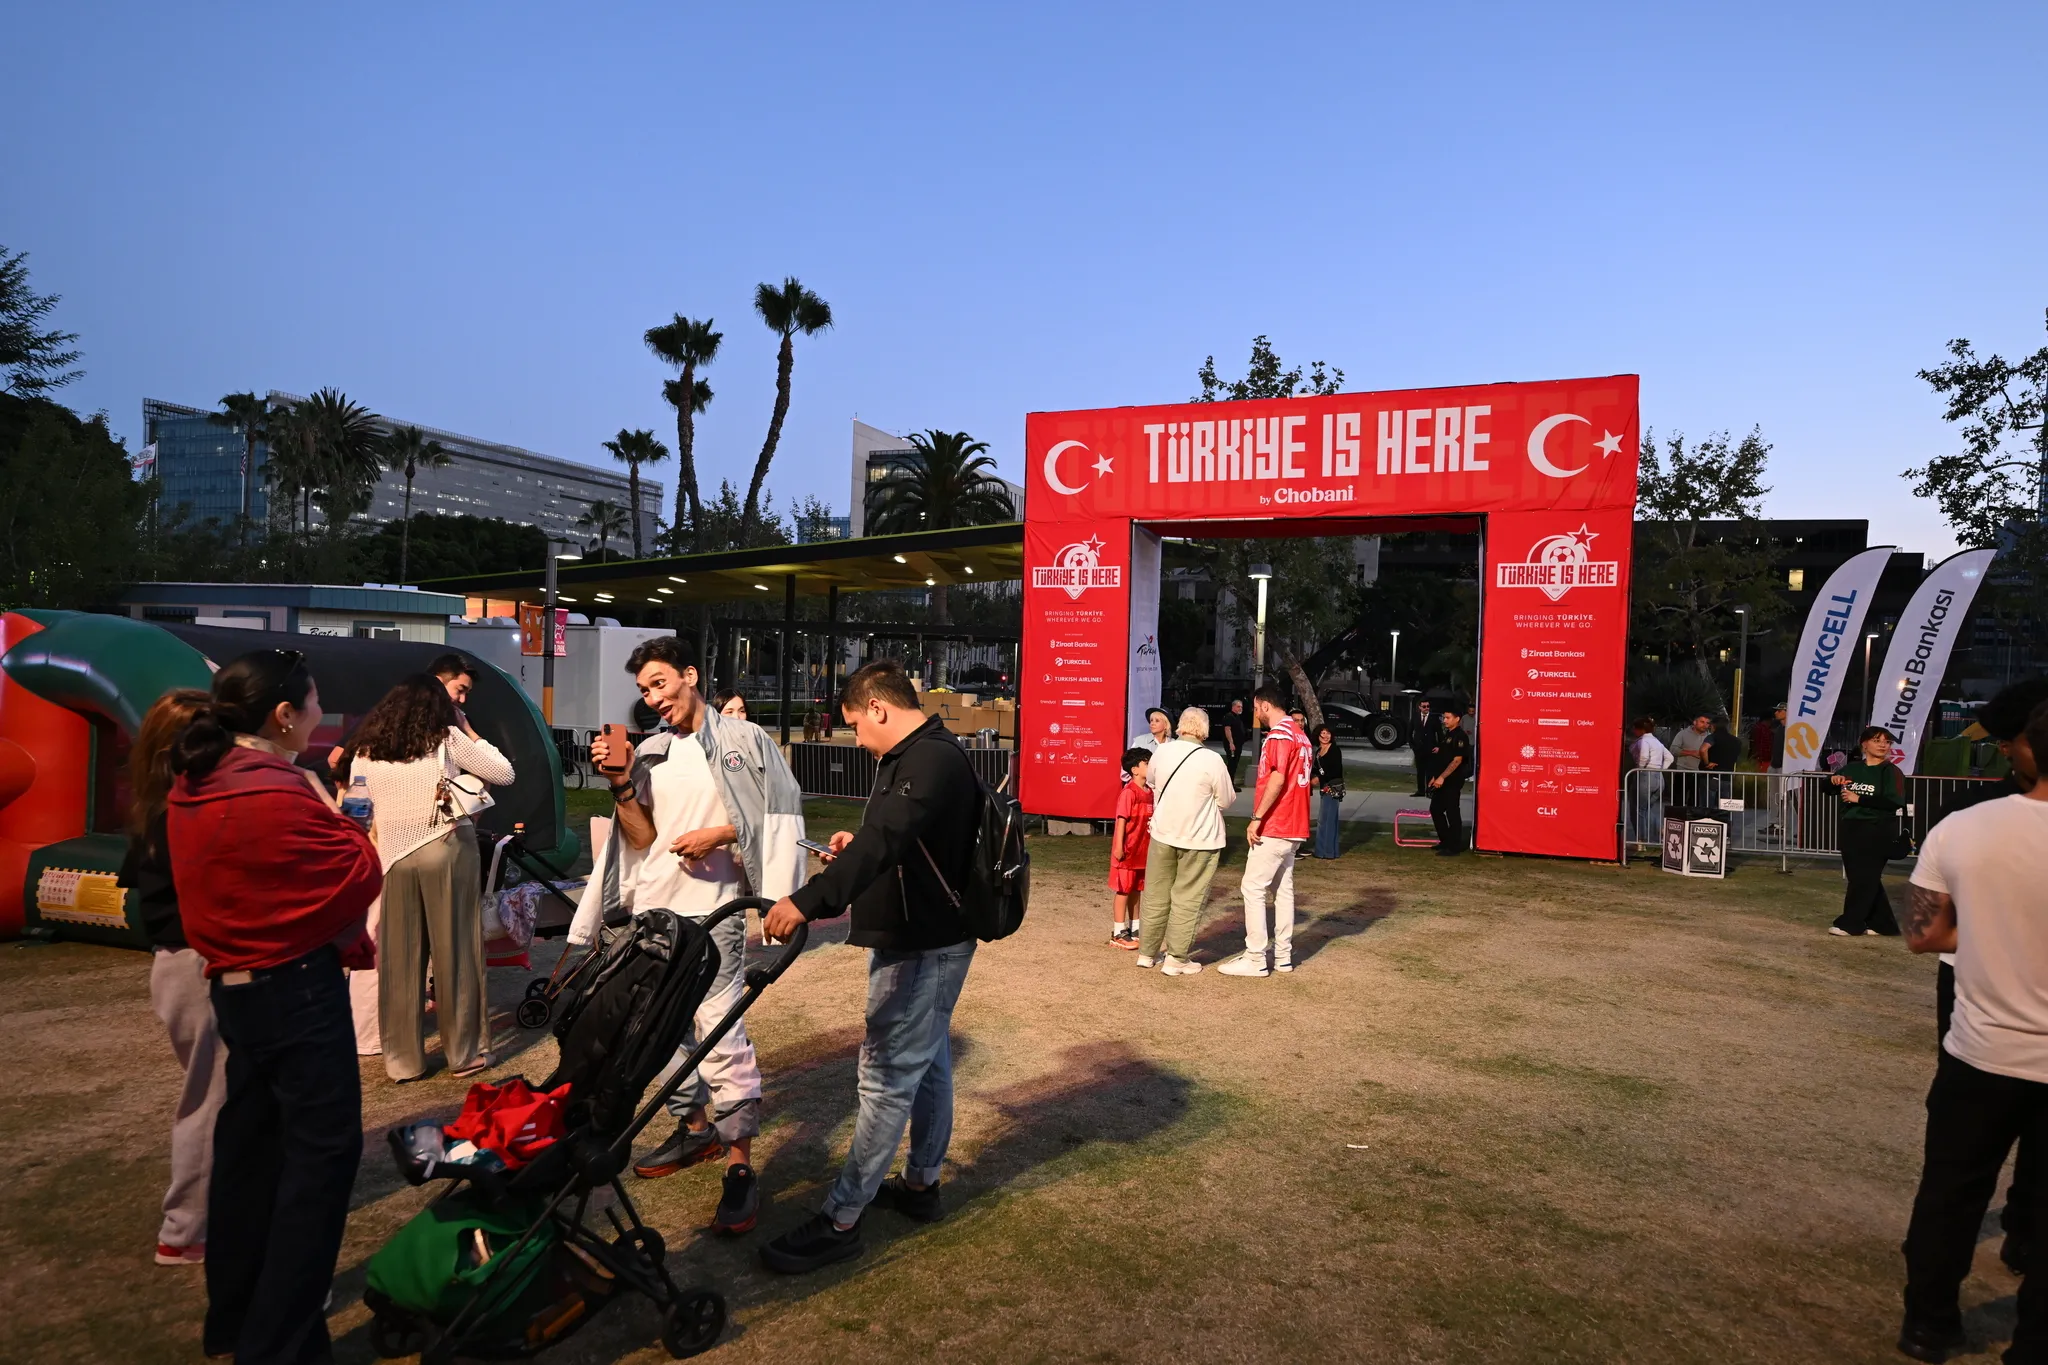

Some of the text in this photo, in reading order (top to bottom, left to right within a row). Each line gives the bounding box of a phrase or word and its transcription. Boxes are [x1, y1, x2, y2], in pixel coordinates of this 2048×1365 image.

[1143, 404, 1491, 483] TÜRKİYE IS HERE
[1259, 484, 1354, 506] by Chobani
[1078, 568, 1088, 586] IS
[1091, 568, 1118, 585] HERE
[1500, 564, 1614, 585] TÜRKİYE IS HERE
[1554, 650, 1586, 658] Bankası
[1797, 589, 1858, 717] TURKCELL
[1884, 588, 1956, 745] Ziraat Bankası
[1061, 775, 1077, 783] CLK
[1537, 807, 1558, 816] CLK
